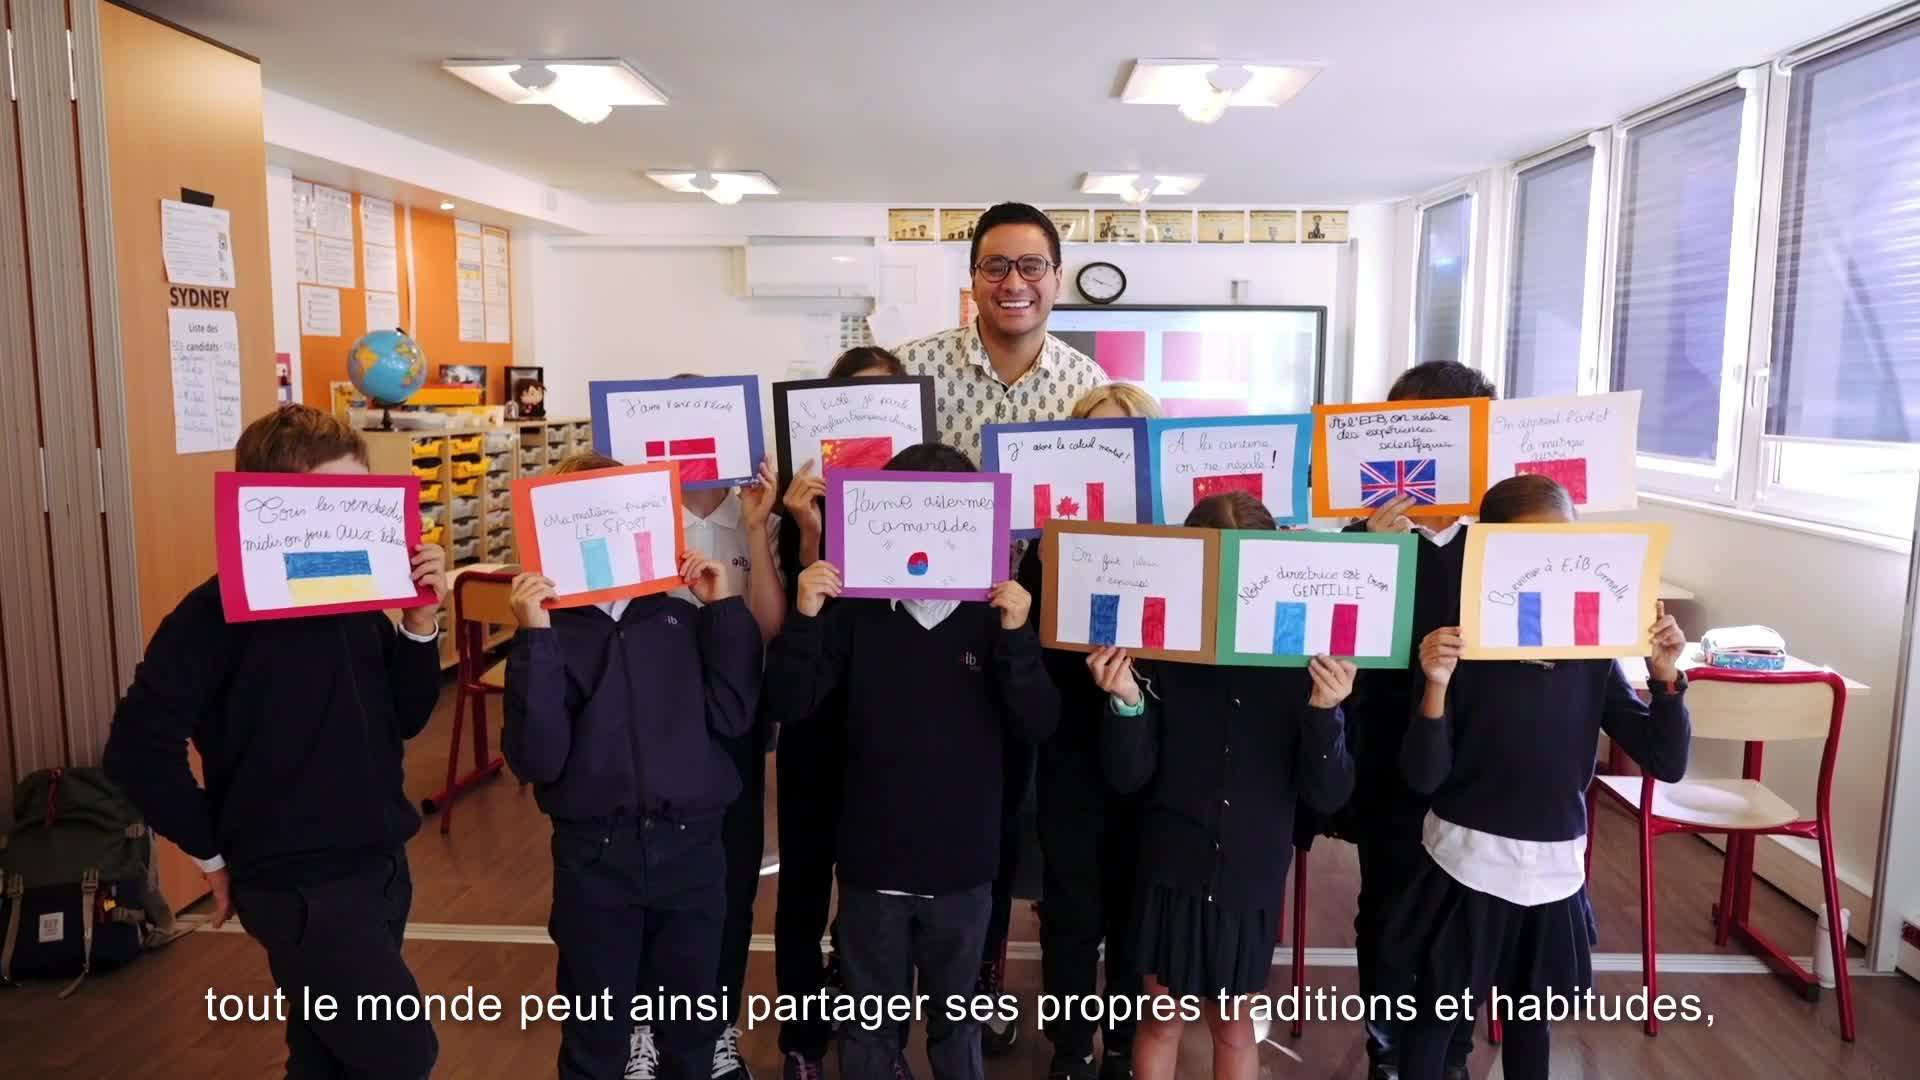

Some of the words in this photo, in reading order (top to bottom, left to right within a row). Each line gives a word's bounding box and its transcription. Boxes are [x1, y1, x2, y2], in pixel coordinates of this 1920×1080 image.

[169, 286, 230, 309] SYDNEY
[188, 322, 205, 334] Liste
[206, 323, 219, 335] des
[186, 341, 220, 353] candidats
[1390, 413, 1410, 424] on
[1336, 428, 1359, 441] des
[1069, 436, 1096, 450] calcul
[1175, 463, 1196, 474] on
[244, 496, 307, 524] Tous
[315, 496, 335, 513] les
[575, 522, 594, 540] LE
[602, 516, 648, 534] SPORT
[304, 527, 331, 549] joue
[1276, 565, 1338, 581] directrice
[1342, 568, 1361, 580] est
[1292, 583, 1365, 600] GENTILLE
